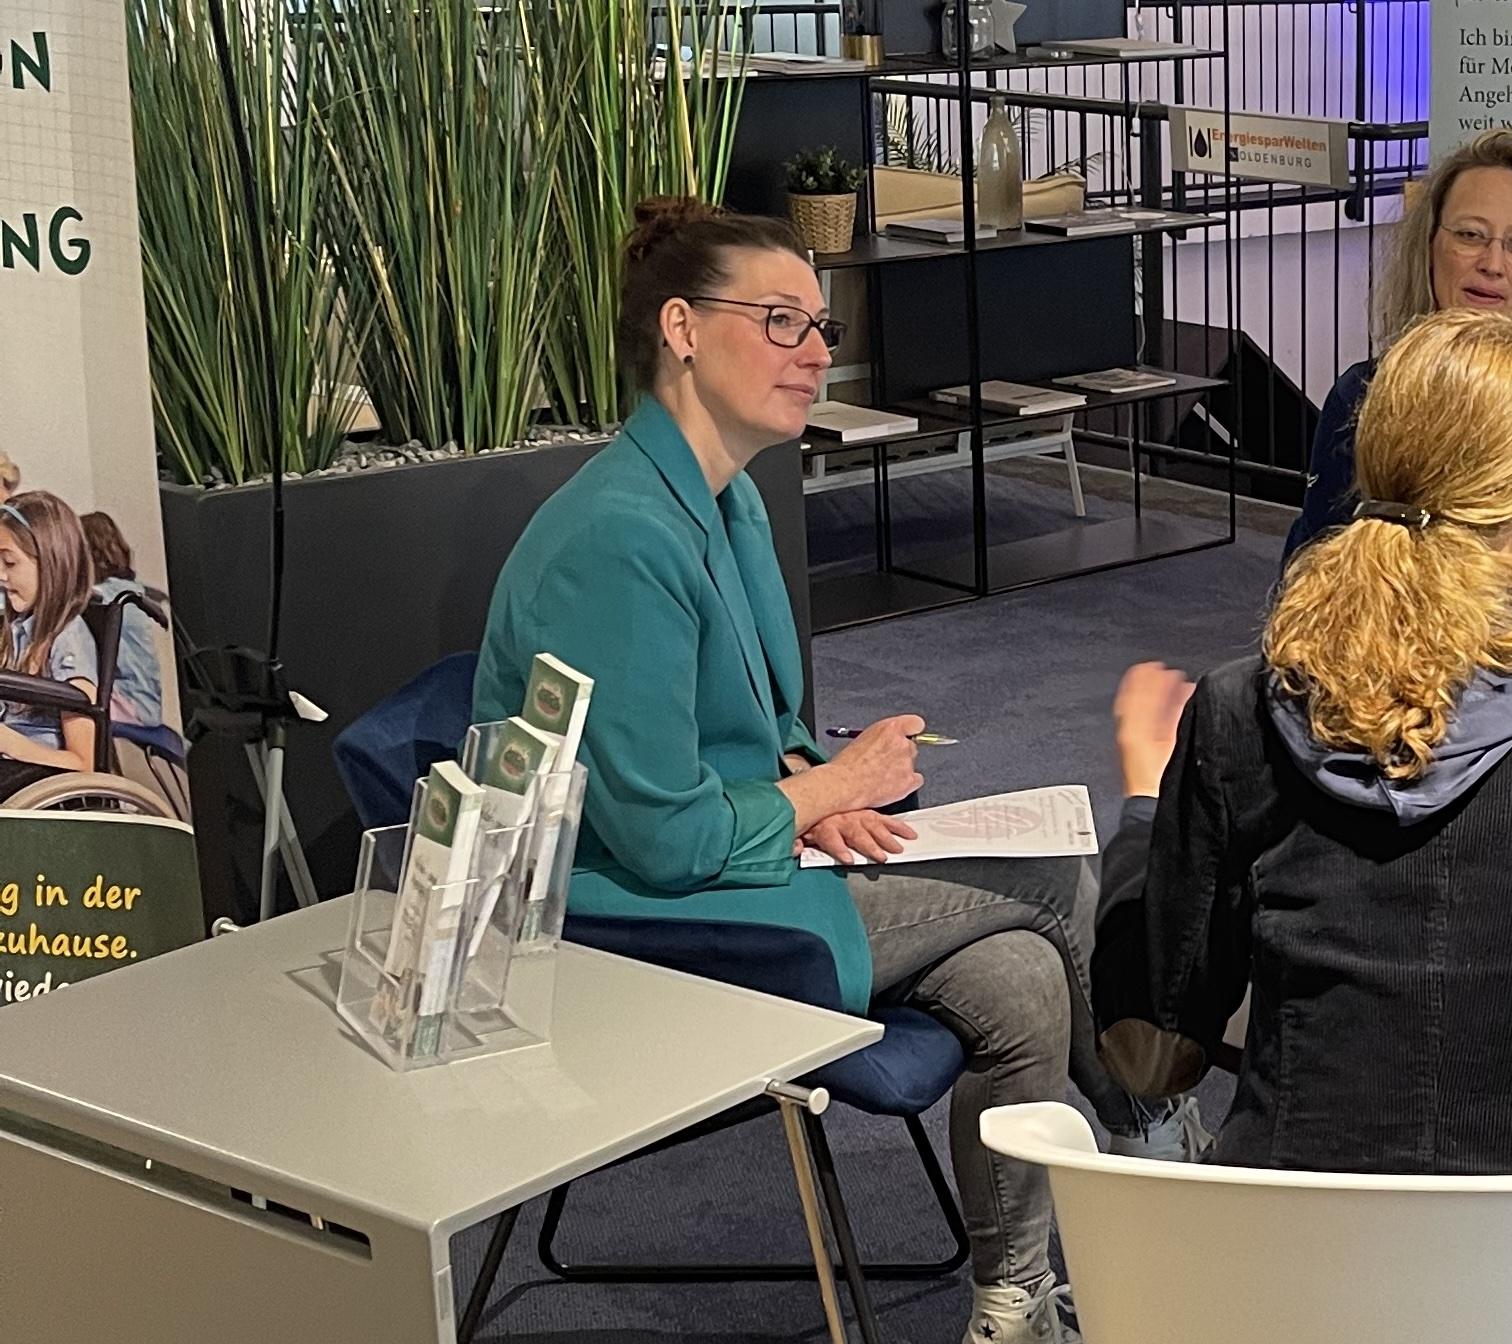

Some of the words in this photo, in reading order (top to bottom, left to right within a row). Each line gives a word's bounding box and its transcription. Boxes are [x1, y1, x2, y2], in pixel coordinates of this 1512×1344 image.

[1459, 27, 1486, 46] Ich
[0, 31, 51, 93] N
[1459, 56, 1486, 74] für
[1458, 115, 1495, 130] weit
[1239, 150, 1312, 168] OLDENBURG
[36, 874, 69, 907] in
[83, 874, 142, 910] der
